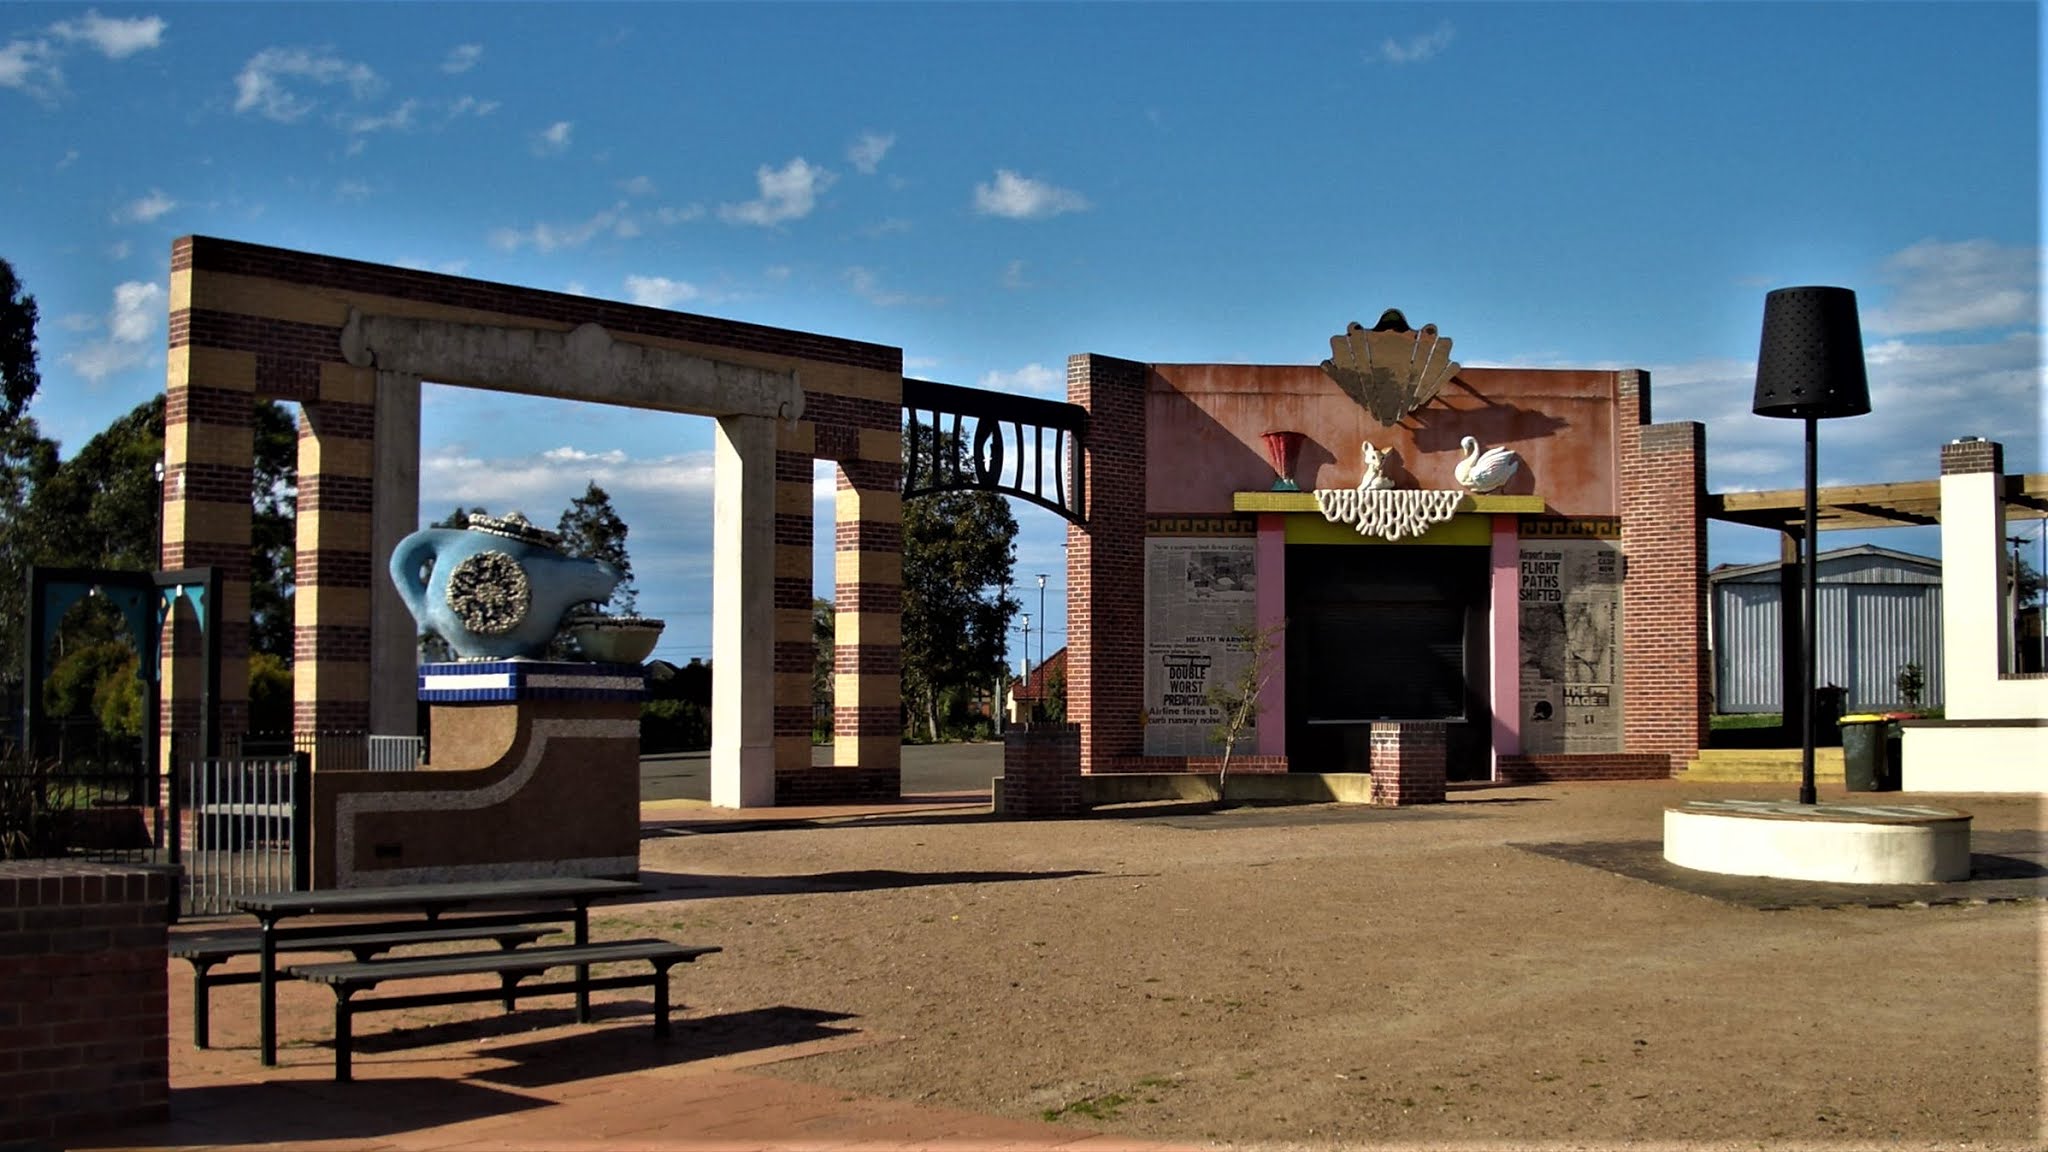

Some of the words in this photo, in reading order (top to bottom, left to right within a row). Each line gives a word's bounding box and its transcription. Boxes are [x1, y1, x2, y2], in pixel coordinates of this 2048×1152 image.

[1521, 562, 1560, 574] FLIGHT
[1522, 575, 1559, 588] PATHS
[1519, 589, 1561, 601] SHIFTED
[1169, 667, 1206, 679] DOUBLE
[1170, 681, 1204, 693] WORST
[1563, 686, 1589, 696] THE
[1564, 696, 1598, 706] RAGE
[1149, 707, 1180, 715] Airline
[1183, 707, 1206, 715] fines
[1209, 707, 1219, 715] to
[1148, 716, 1167, 724] curb
[1168, 717, 1198, 726] runway
